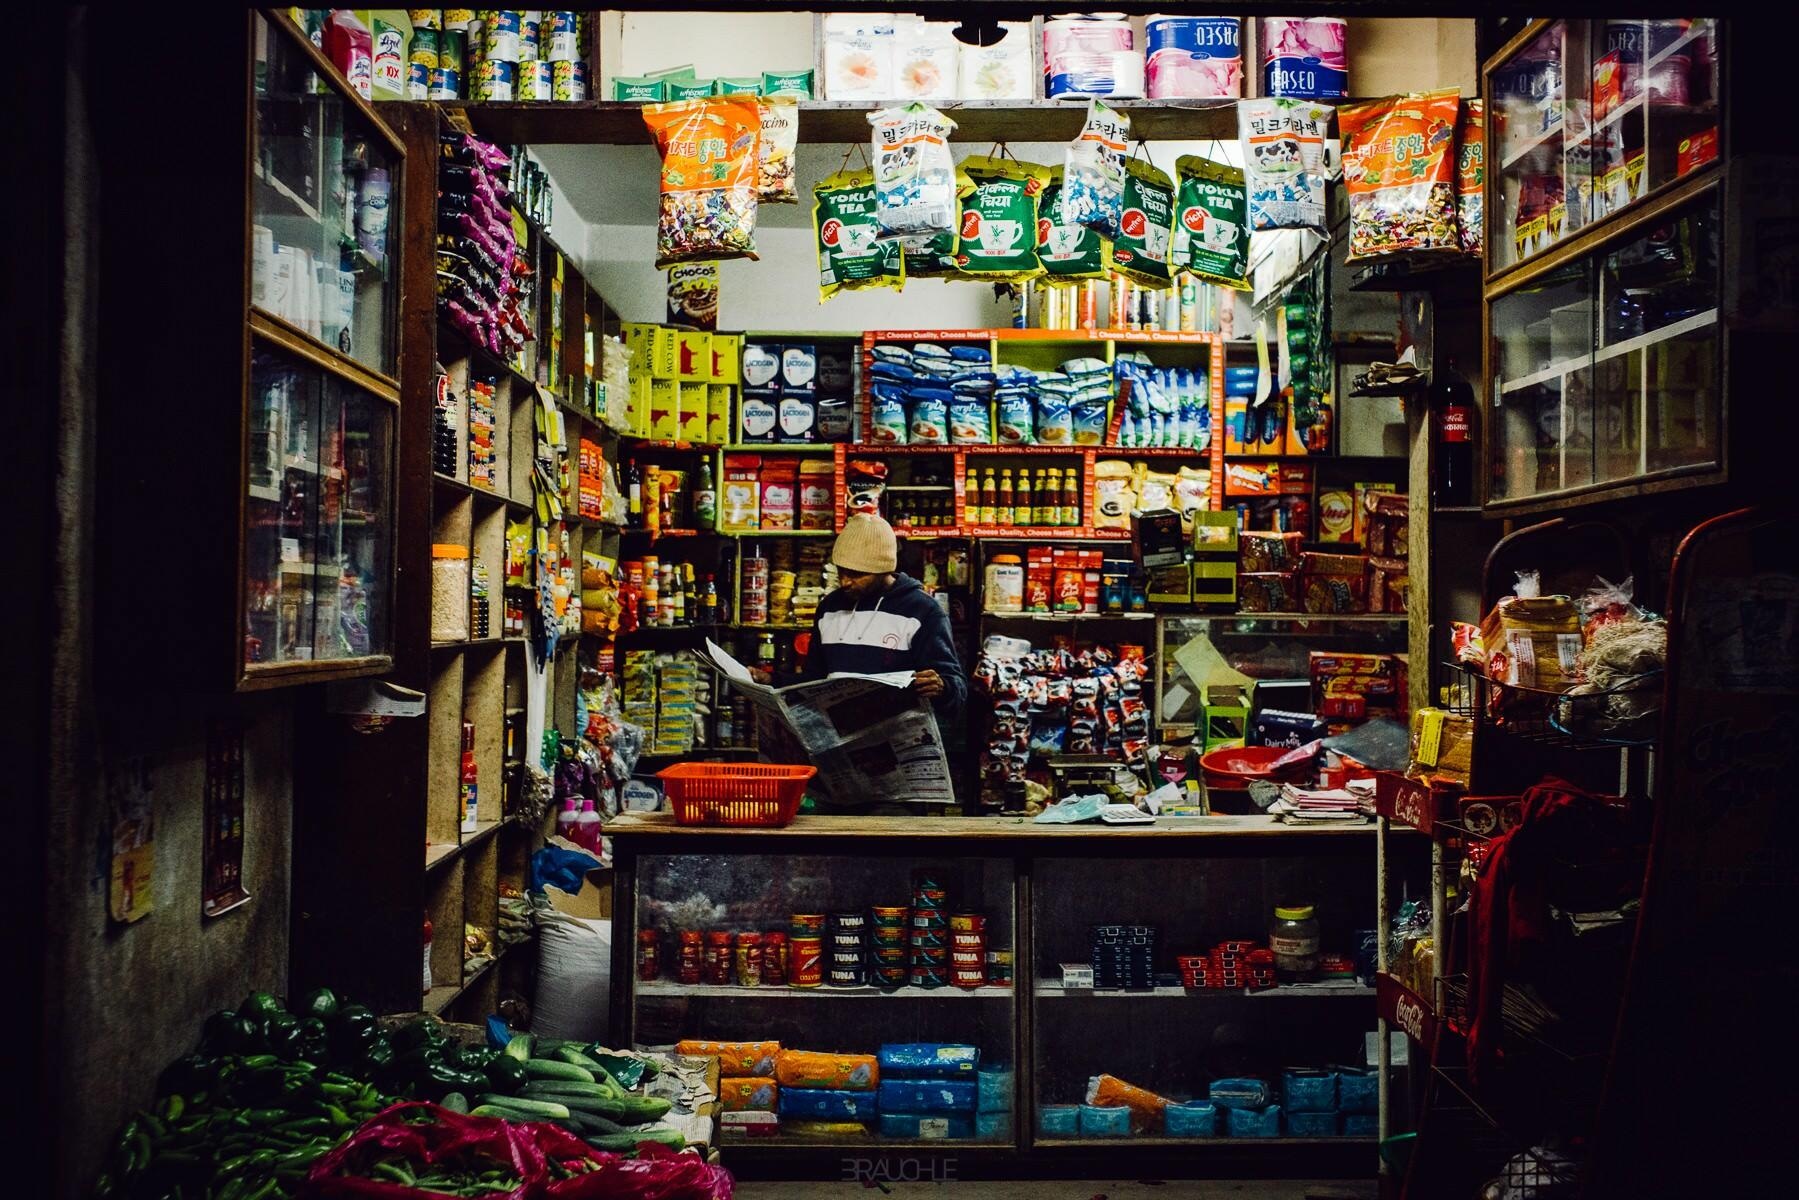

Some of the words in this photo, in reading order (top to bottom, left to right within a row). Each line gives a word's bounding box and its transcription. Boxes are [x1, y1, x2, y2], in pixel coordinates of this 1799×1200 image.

[1196, 26, 1239, 47] PASEO
[386, 65, 399, 79] 10X
[774, 78, 803, 87] whisper
[1270, 70, 1315, 90] PASEO
[626, 86, 655, 94] whisper
[679, 88, 708, 96] whisper
[1196, 183, 1244, 200] TOKLA
[829, 190, 877, 205] TOKLA
[838, 203, 866, 214] TEA
[1207, 196, 1234, 211] TEA
[1185, 208, 1205, 225] rich
[823, 222, 838, 241] rich
[673, 266, 716, 279] CHOCOS
[647, 327, 655, 347] RED
[886, 331, 912, 339] Choose
[912, 331, 939, 339] Quality,
[646, 347, 654, 370] COW
[747, 368, 751, 376] 1
[745, 409, 773, 418] LACTOGEN
[783, 409, 810, 418] LACTOGEN
[746, 418, 751, 426] 1
[784, 418, 788, 426] 1
[999, 528, 1026, 536] Quality,
[1265, 738, 1285, 748] Dairy
[1286, 737, 1302, 748] Milk
[839, 917, 864, 926] TUNA
[835, 935, 860, 944] TUNA
[955, 935, 981, 944] TUNA
[833, 953, 859, 962] TUNA
[952, 952, 978, 962] TUNA
[831, 970, 855, 980] TUNA
[957, 970, 983, 980] TUNA
